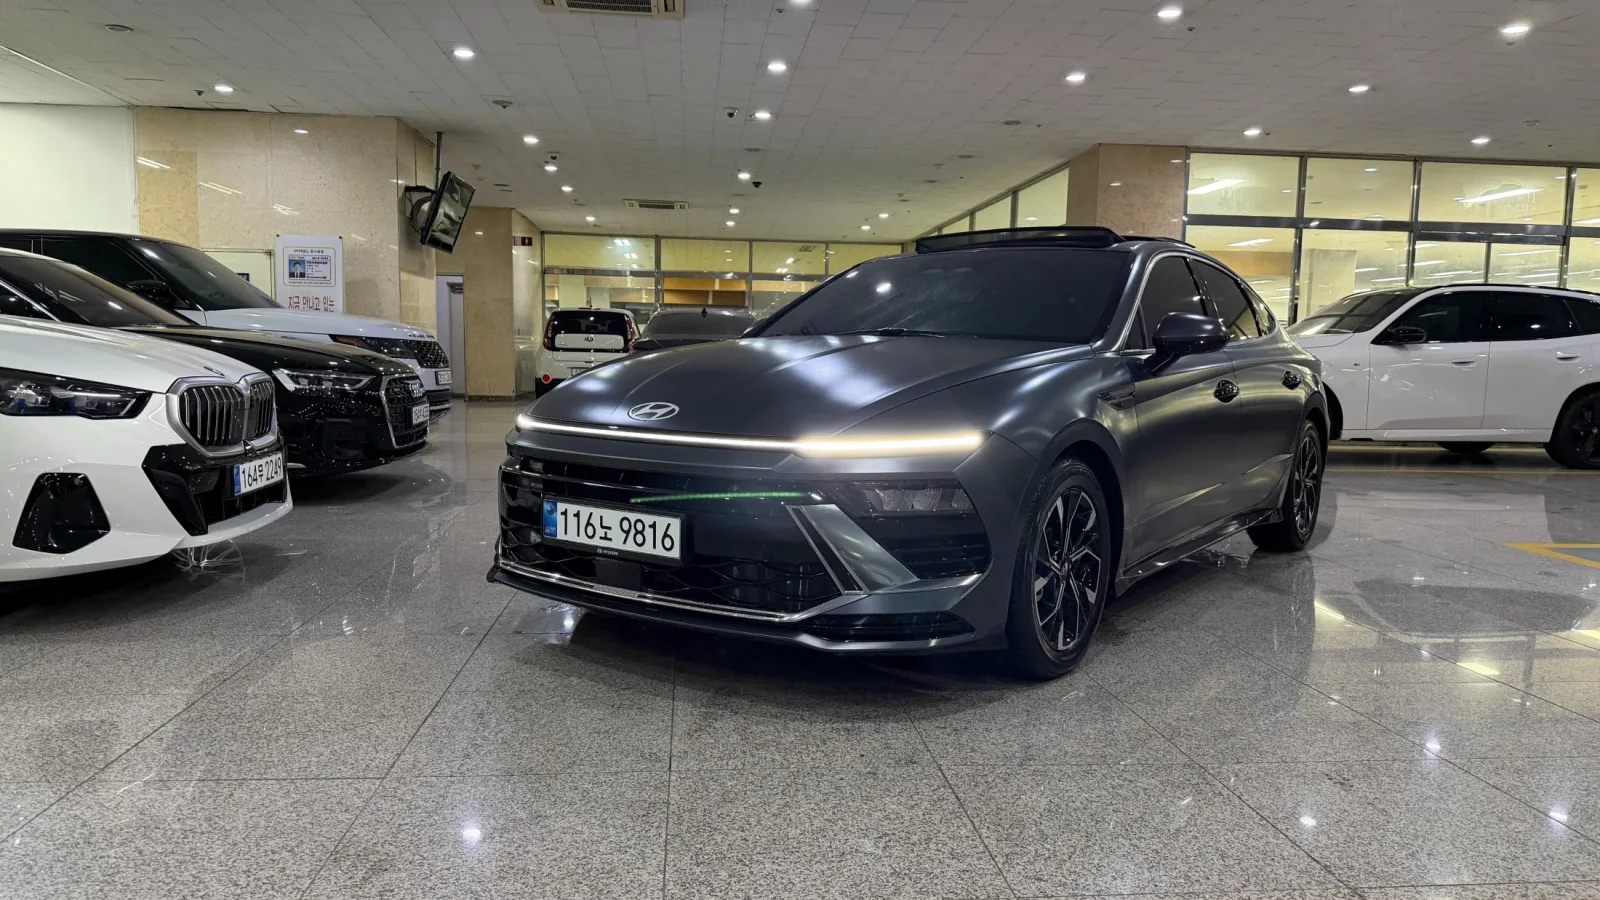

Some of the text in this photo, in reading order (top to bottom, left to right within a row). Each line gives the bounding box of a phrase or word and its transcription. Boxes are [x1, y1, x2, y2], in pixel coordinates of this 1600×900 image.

[288, 295, 335, 312] 지금 만나고 있는
[242, 457, 281, 488] 164무 2249
[560, 508, 675, 552] 116노 9816
